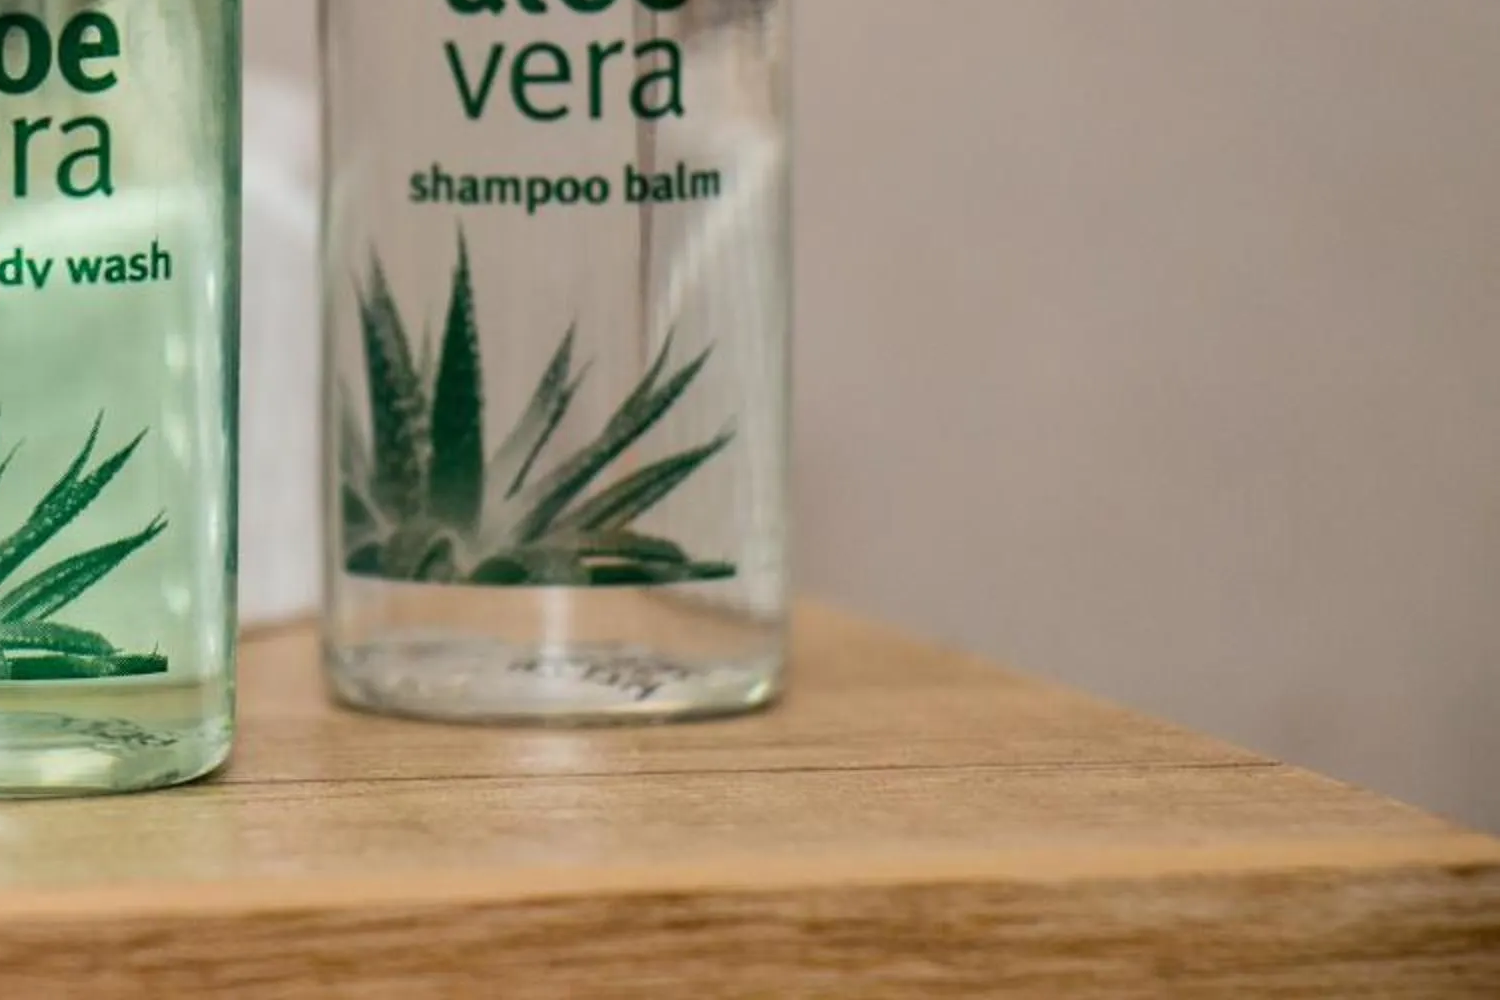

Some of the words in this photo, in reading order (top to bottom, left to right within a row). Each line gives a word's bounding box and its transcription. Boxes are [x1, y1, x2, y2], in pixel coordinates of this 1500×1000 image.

[444, 39, 685, 122] vera
[408, 161, 611, 215] shampoo
[624, 161, 721, 202] balm
[66, 235, 172, 285] wash
